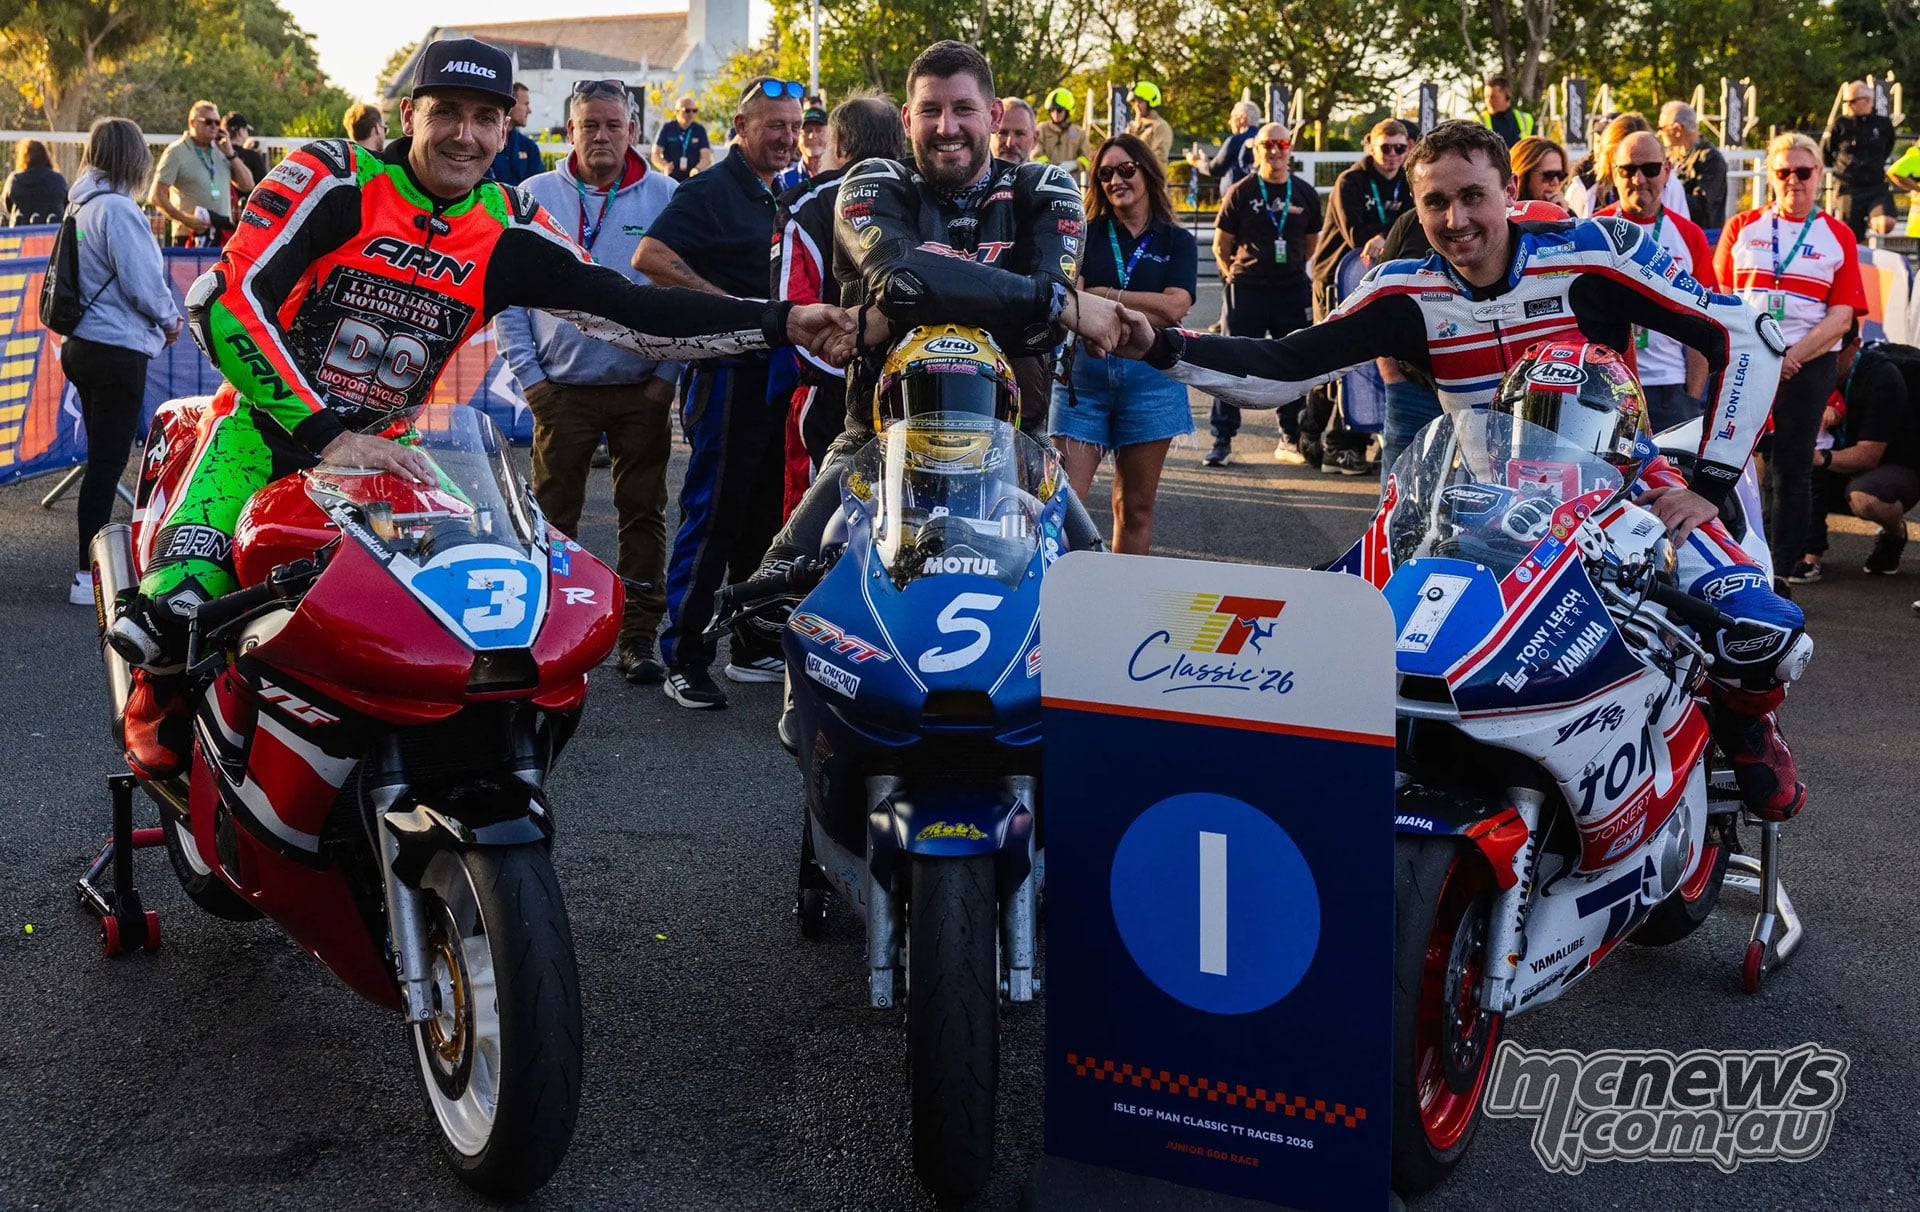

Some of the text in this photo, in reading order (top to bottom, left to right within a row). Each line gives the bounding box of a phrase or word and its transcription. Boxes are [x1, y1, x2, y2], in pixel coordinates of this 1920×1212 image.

[440, 60, 497, 79] Mitas
[362, 236, 476, 286] ARN
[342, 291, 439, 330] MOTORS LTD
[377, 287, 442, 316] CULLISS
[322, 316, 430, 393] DC
[935, 338, 974, 351] Arai
[224, 333, 295, 401] ARN
[1536, 363, 1579, 380] Arai
[1734, 353, 1750, 388] LEACH
[1724, 389, 1741, 419] TONY
[1702, 465, 1739, 480] RST
[164, 525, 234, 562] ARN
[922, 556, 999, 576] MOTUL
[462, 568, 528, 634] 3
[1702, 573, 1769, 604] RST
[1395, 573, 1473, 654] 1
[1545, 588, 1582, 631] LEACH
[787, 612, 893, 665] SMT
[918, 592, 1004, 673] 5
[1516, 625, 1551, 665] TONY
[1530, 596, 1590, 672] JOINERY
[1552, 620, 1608, 679] YAMAHA
[1724, 630, 1782, 653] RST
[806, 656, 858, 695] NEIL ORFORD
[1128, 630, 1259, 683] Classic
[1590, 790, 1652, 844] JOINERY
[1529, 935, 1586, 974] YAMALUBE
[1113, 1102, 1314, 1150] ISLE OF MAN CLASSIC TT RACES 2026
[1165, 1141, 1260, 1167] JUNIOR 600 RACE
